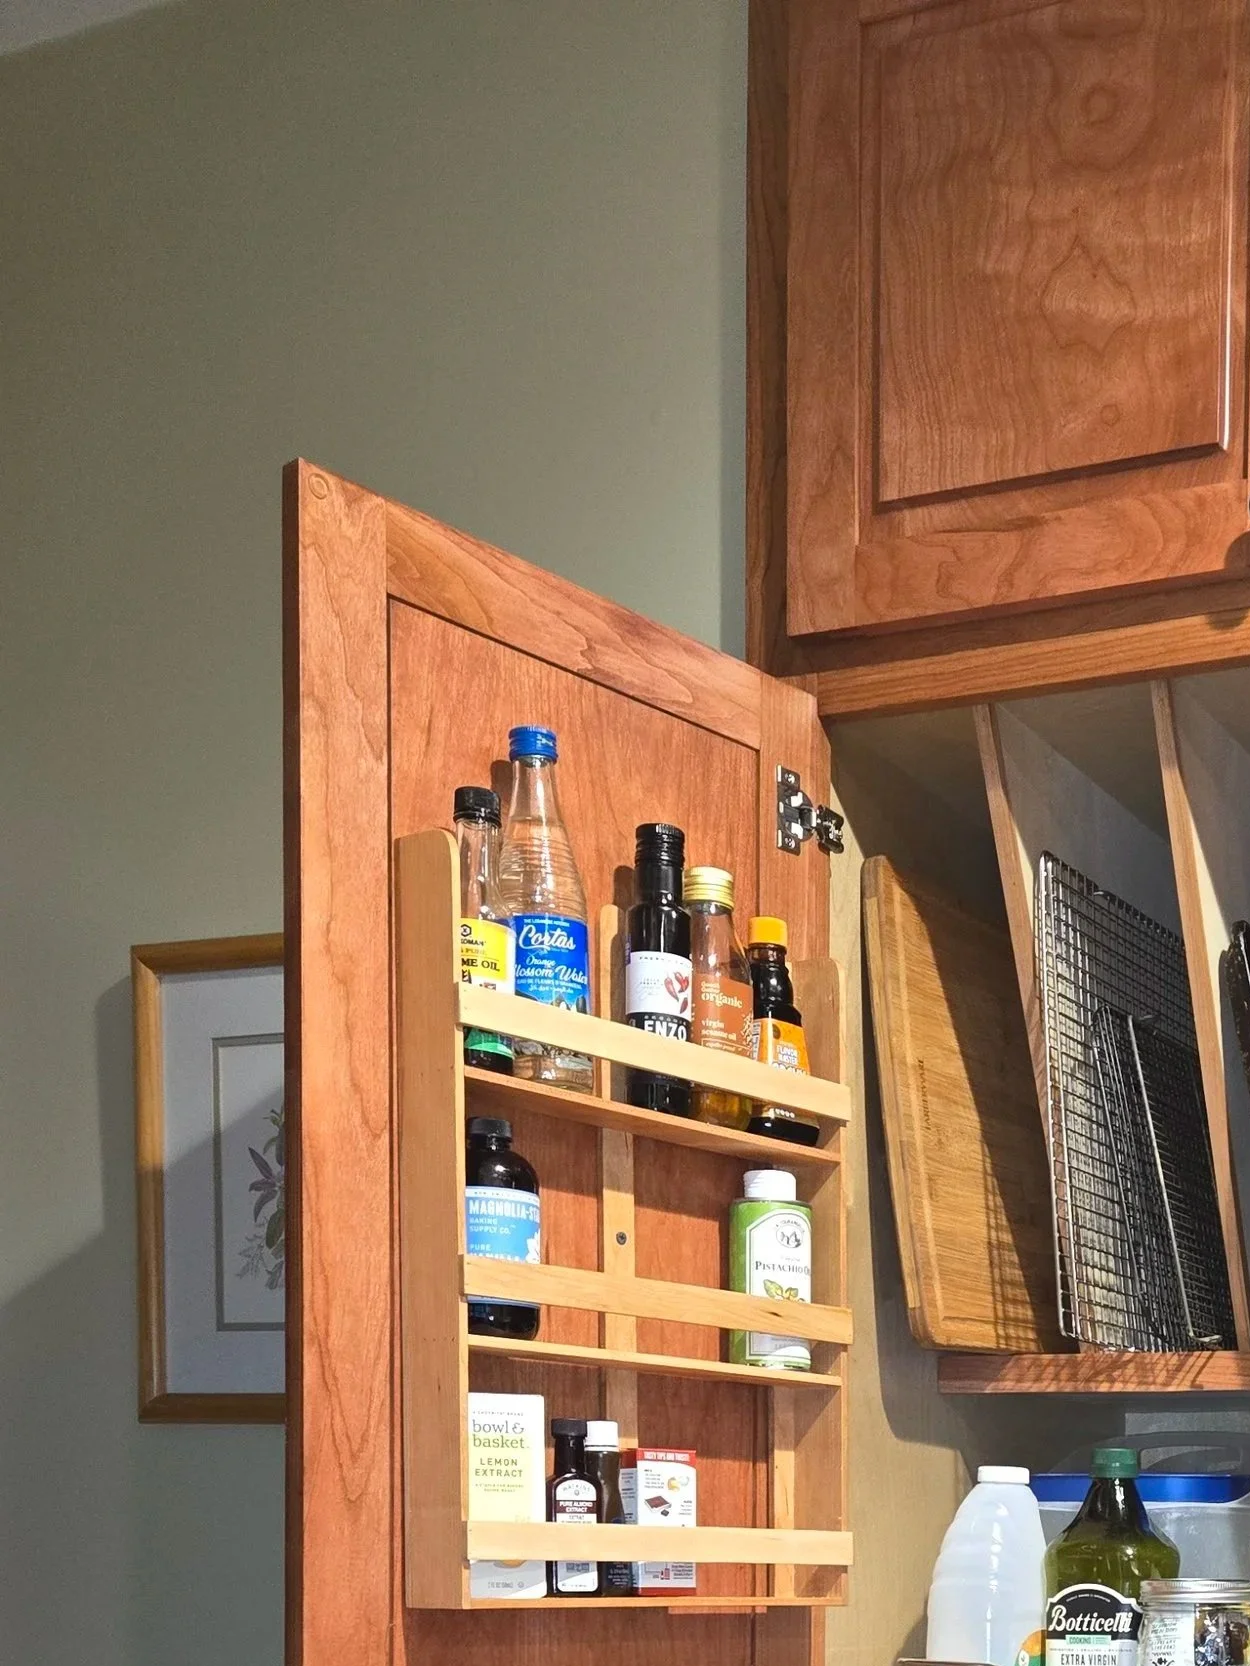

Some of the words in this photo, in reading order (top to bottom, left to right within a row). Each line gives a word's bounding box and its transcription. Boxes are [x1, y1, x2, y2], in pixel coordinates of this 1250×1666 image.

[519, 924, 576, 951] Cortas
[481, 960, 500, 972] OIL
[515, 964, 552, 978] lossom
[701, 991, 743, 1009] organic
[644, 1020, 688, 1042] ENZO
[470, 1217, 497, 1225] BAKING
[470, 1243, 491, 1251] PURE
[472, 1419, 509, 1434] bowl
[512, 1422, 525, 1435] &
[472, 1433, 525, 1449] basket
[479, 1457, 518, 1467] LEMON
[474, 1468, 523, 1478] EXTRACT
[1048, 1604, 1133, 1633] Botticelli
[1069, 1636, 1091, 1645] COOKING
[1060, 1653, 1086, 1666] EXTRA
[1091, 1654, 1117, 1666] VIRGIN
